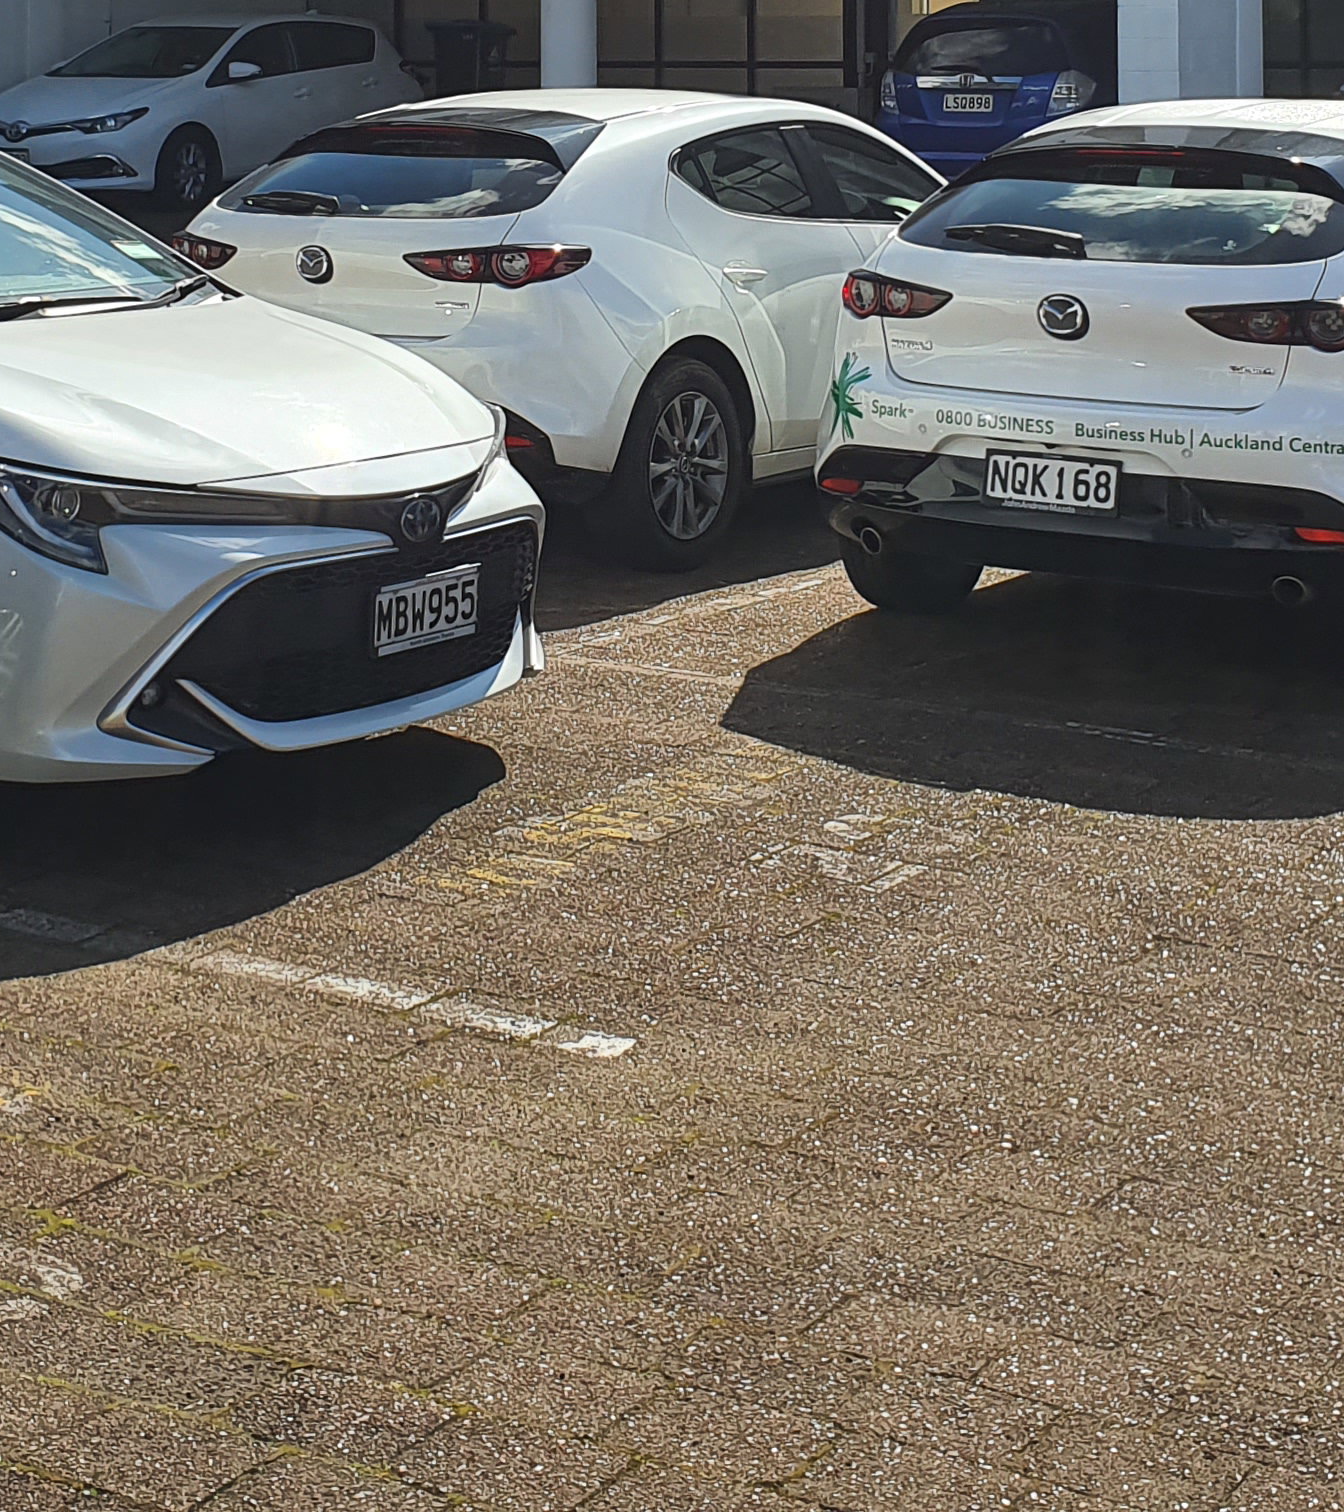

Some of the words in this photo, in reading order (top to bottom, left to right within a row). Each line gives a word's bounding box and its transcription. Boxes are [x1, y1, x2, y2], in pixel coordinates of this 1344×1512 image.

[871, 399, 907, 419] Spark
[936, 409, 973, 427] 0800
[977, 413, 1055, 435] BUSINESS
[1075, 423, 1145, 443] Business
[1150, 428, 1185, 446] Hub
[1199, 432, 1283, 453] Auckland
[990, 459, 1112, 504] NQK168
[377, 579, 475, 642] MBW955
